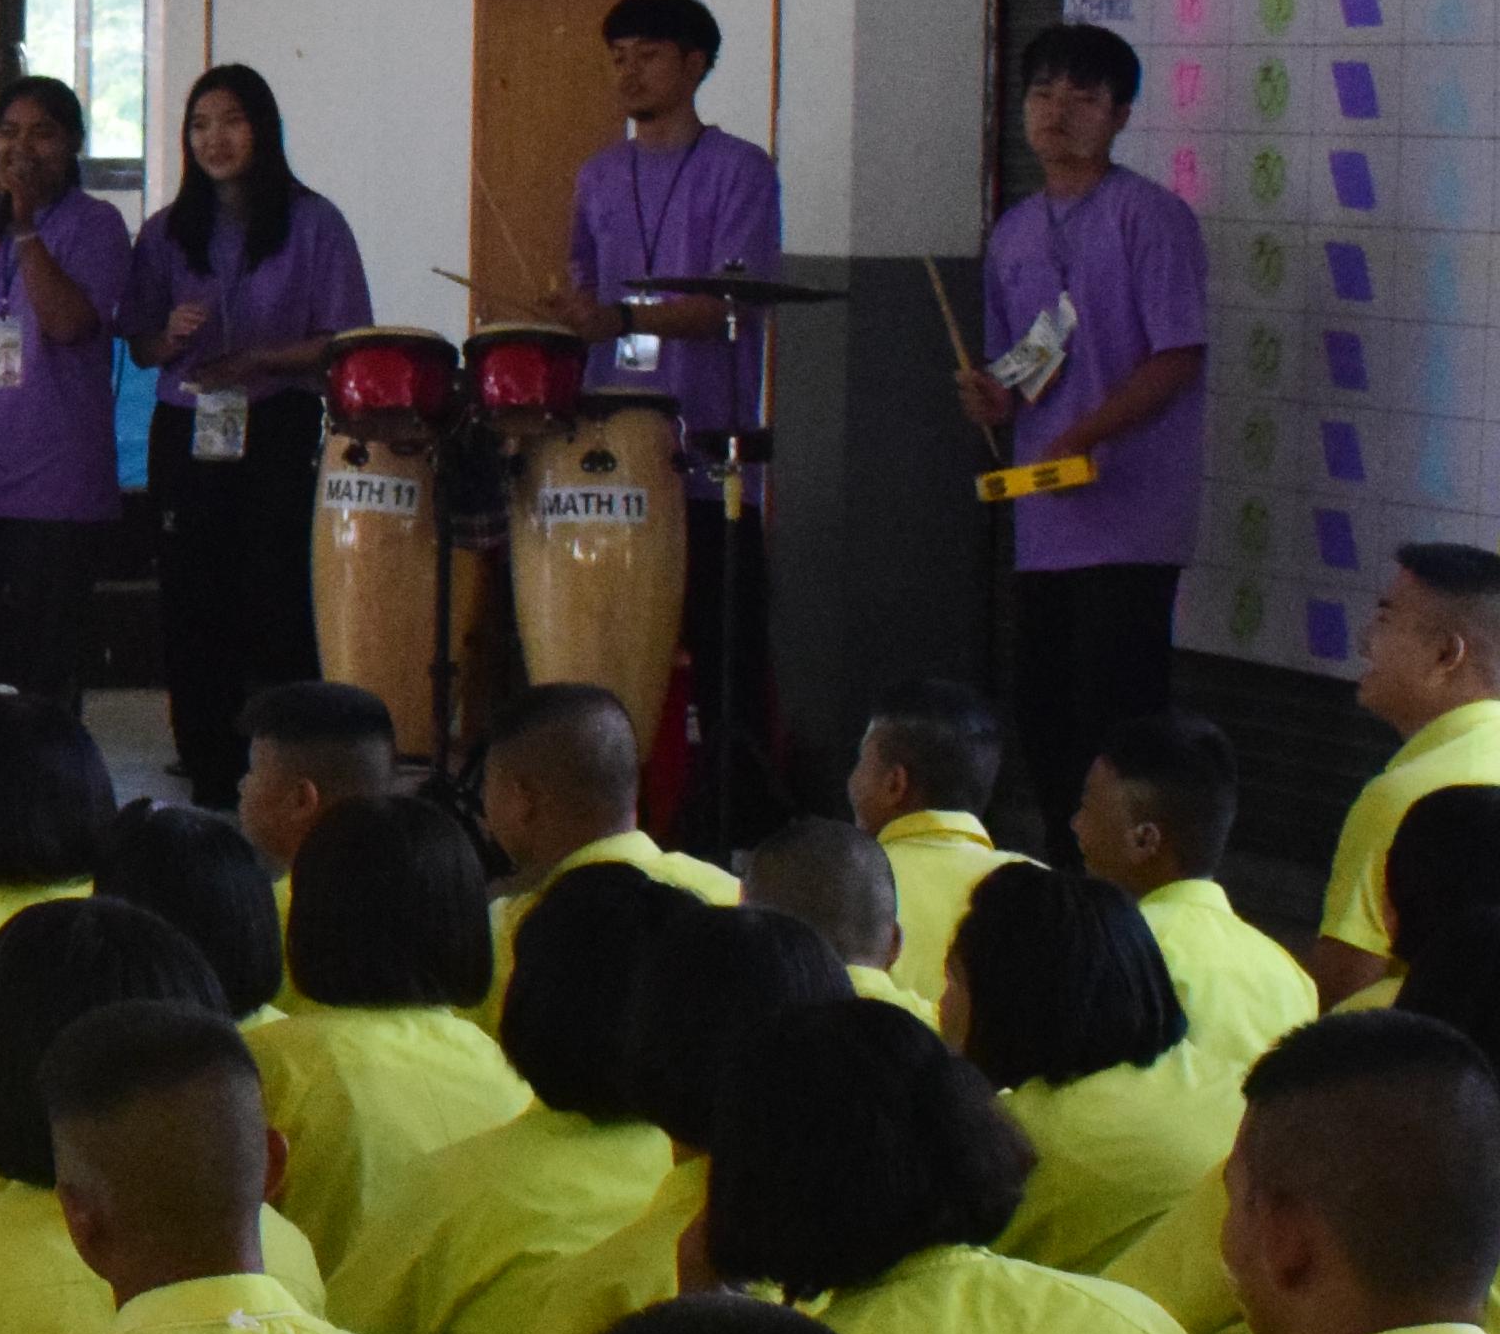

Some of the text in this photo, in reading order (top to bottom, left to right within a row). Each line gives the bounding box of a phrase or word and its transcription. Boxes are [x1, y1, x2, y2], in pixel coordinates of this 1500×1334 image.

[326, 478, 417, 509] MATH 11
[542, 493, 645, 518] MATH 11
